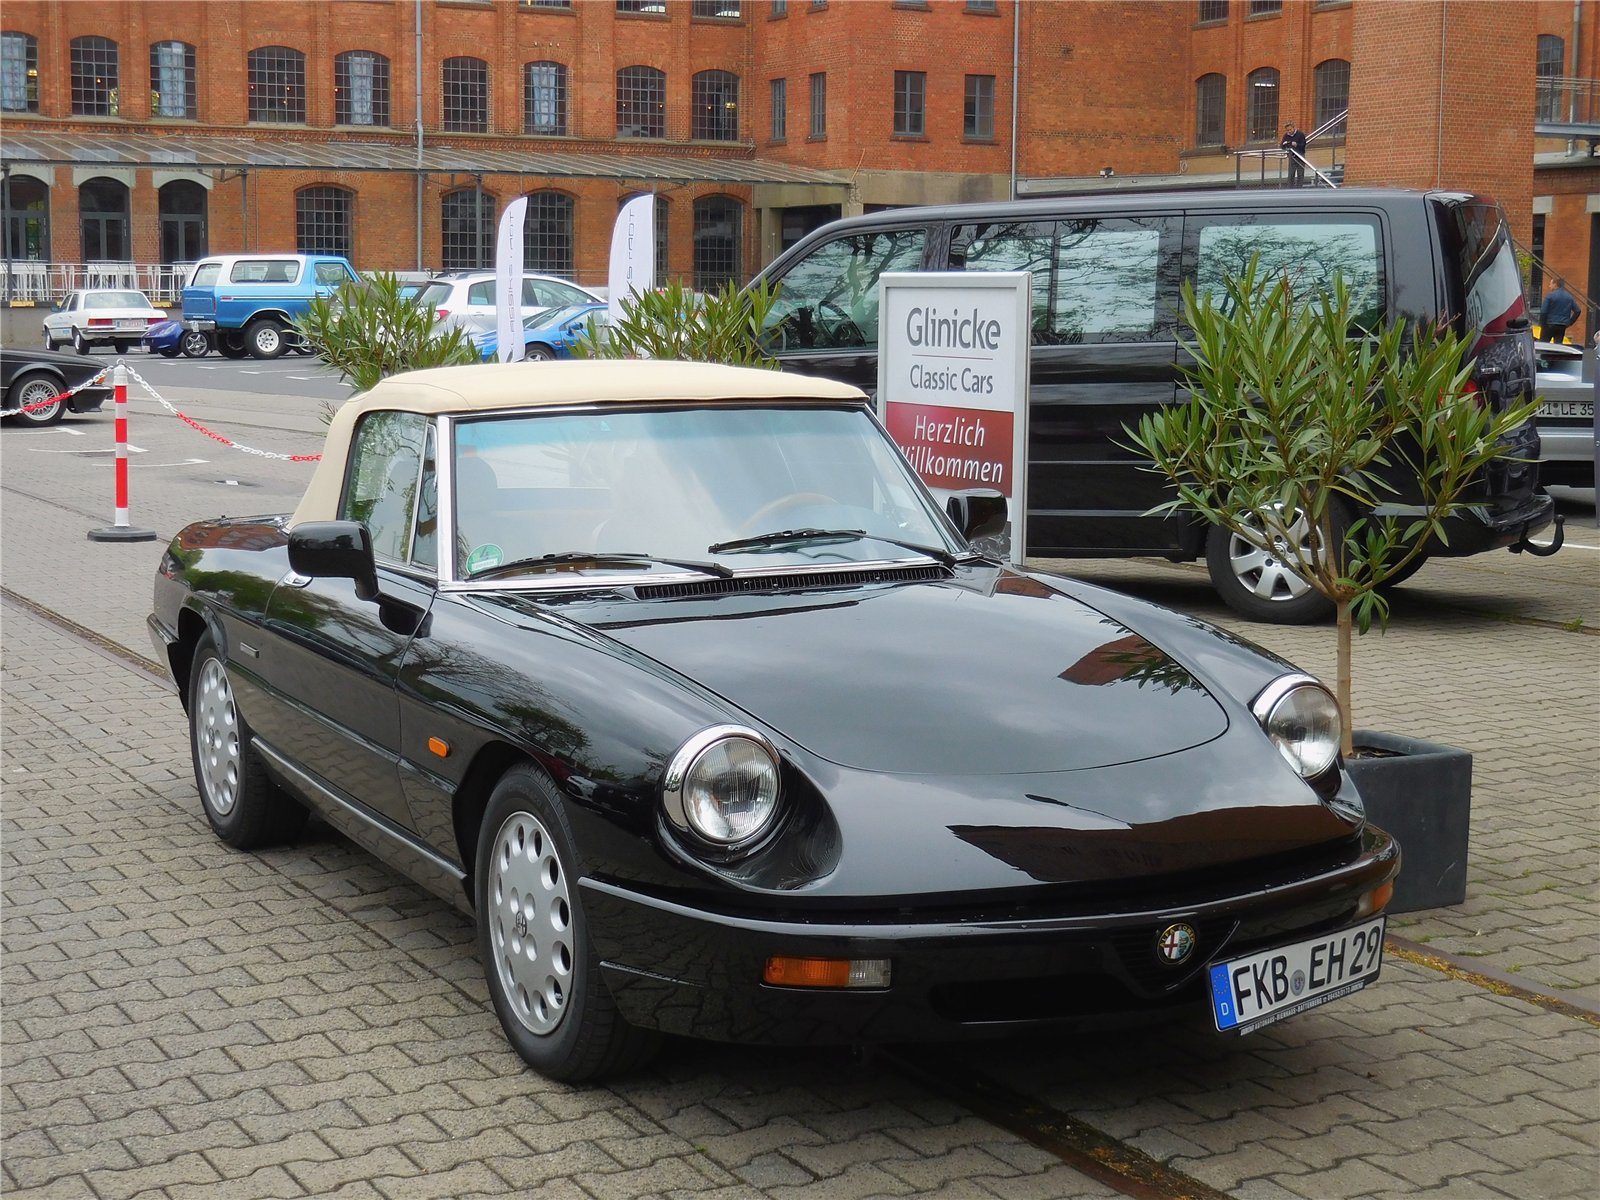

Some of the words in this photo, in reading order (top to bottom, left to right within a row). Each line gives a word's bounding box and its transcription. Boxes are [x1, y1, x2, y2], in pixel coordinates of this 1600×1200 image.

[906, 306, 1001, 351] Glinicke
[909, 364, 958, 392] Classic
[961, 366, 994, 395] Cars
[1560, 403, 1578, 416] LE
[914, 414, 986, 447] Herzlich
[1220, 1002, 1230, 1017] D
[1232, 954, 1289, 1017] FKB
[1308, 937, 1347, 990] EH
[1349, 925, 1381, 977] 29
